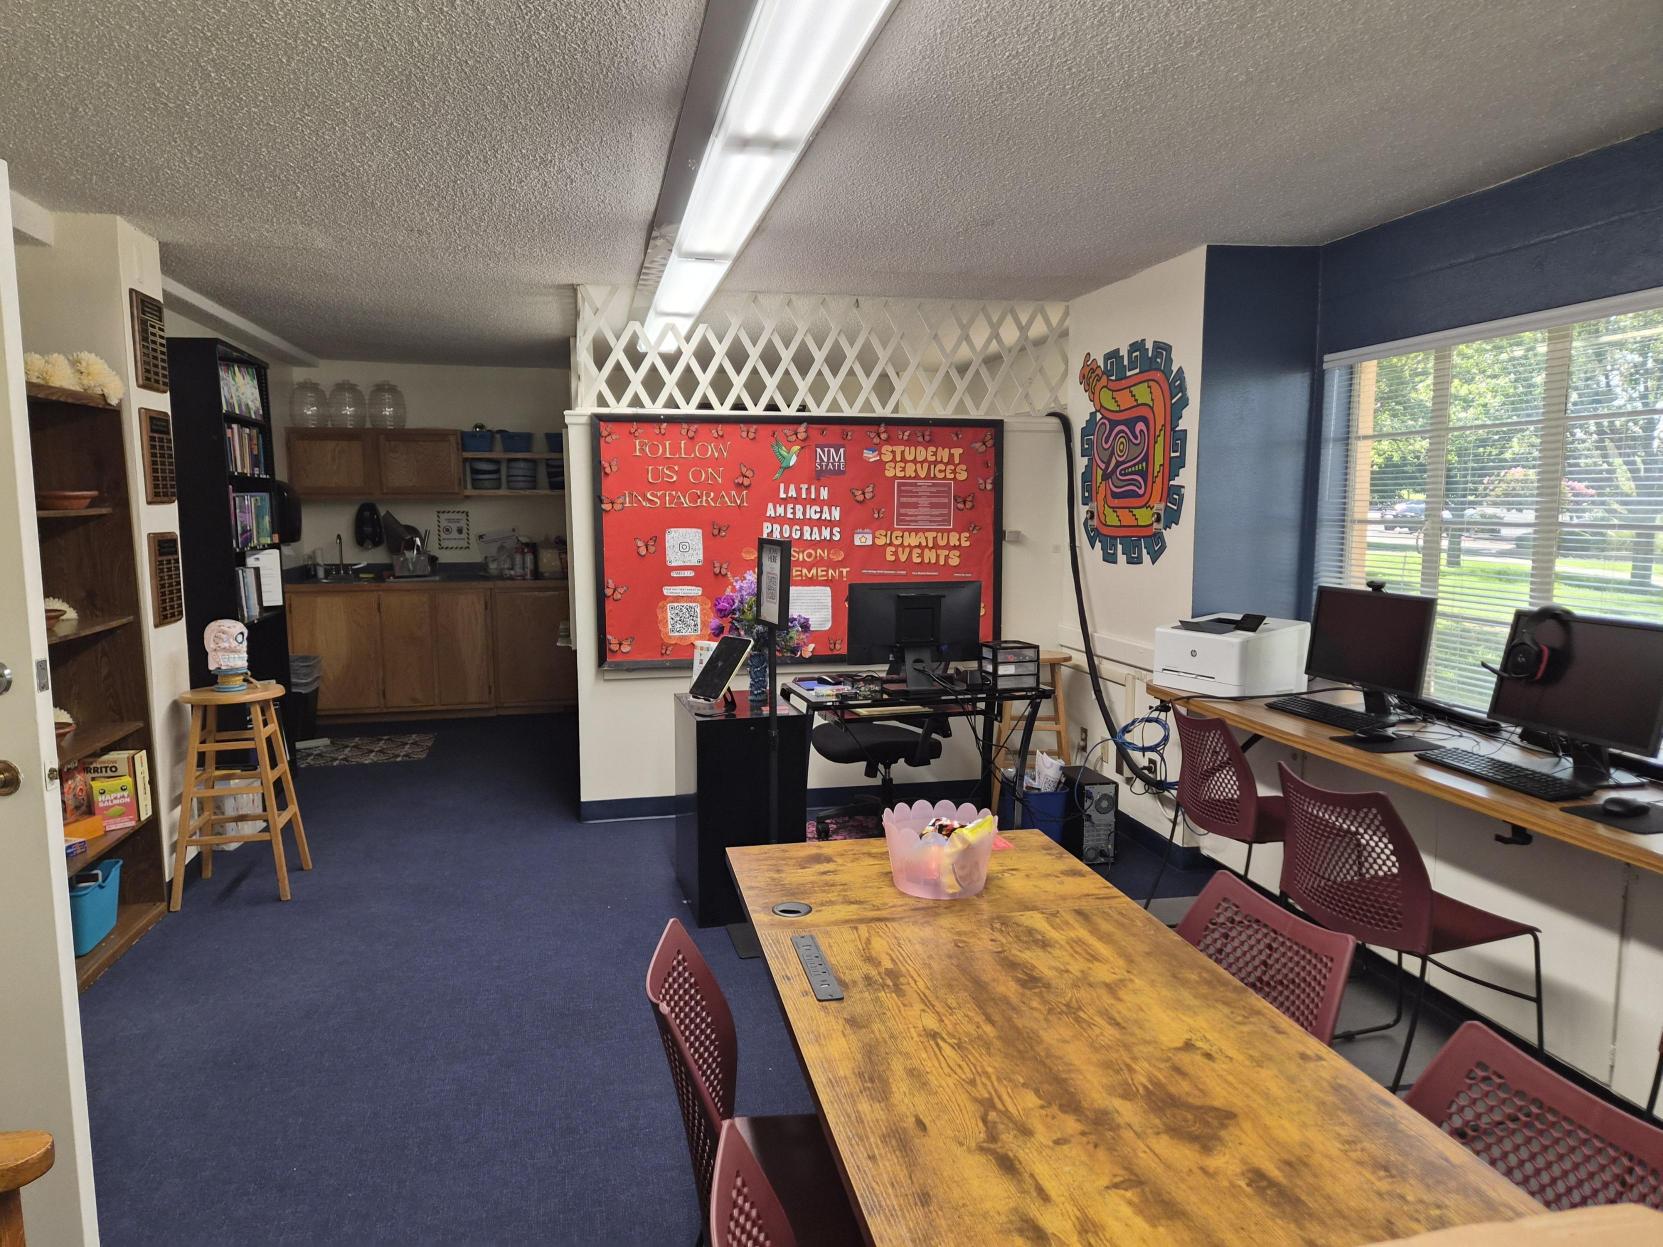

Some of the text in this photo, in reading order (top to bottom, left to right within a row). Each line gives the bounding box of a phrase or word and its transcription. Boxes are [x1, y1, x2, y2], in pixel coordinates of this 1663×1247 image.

[633, 440, 730, 458] FOLLOW
[816, 447, 846, 463] NM
[880, 445, 964, 464] STUDENT
[647, 465, 725, 485] US ON
[815, 462, 846, 471] STATE
[884, 462, 968, 481] SERVICES
[624, 490, 748, 508] INSTAGRAM
[779, 482, 829, 500] LATIN
[765, 503, 841, 521] AMERICAN
[762, 522, 841, 541] PROGRAMS
[874, 529, 971, 547] SIGNATURE
[791, 548, 828, 561] SION
[885, 546, 961, 567] EVENTS
[792, 567, 850, 581] EMENT
[84, 765, 118, 775] RRITO
[98, 797, 131, 808] SALMON
[99, 792, 129, 802] HAPPY
